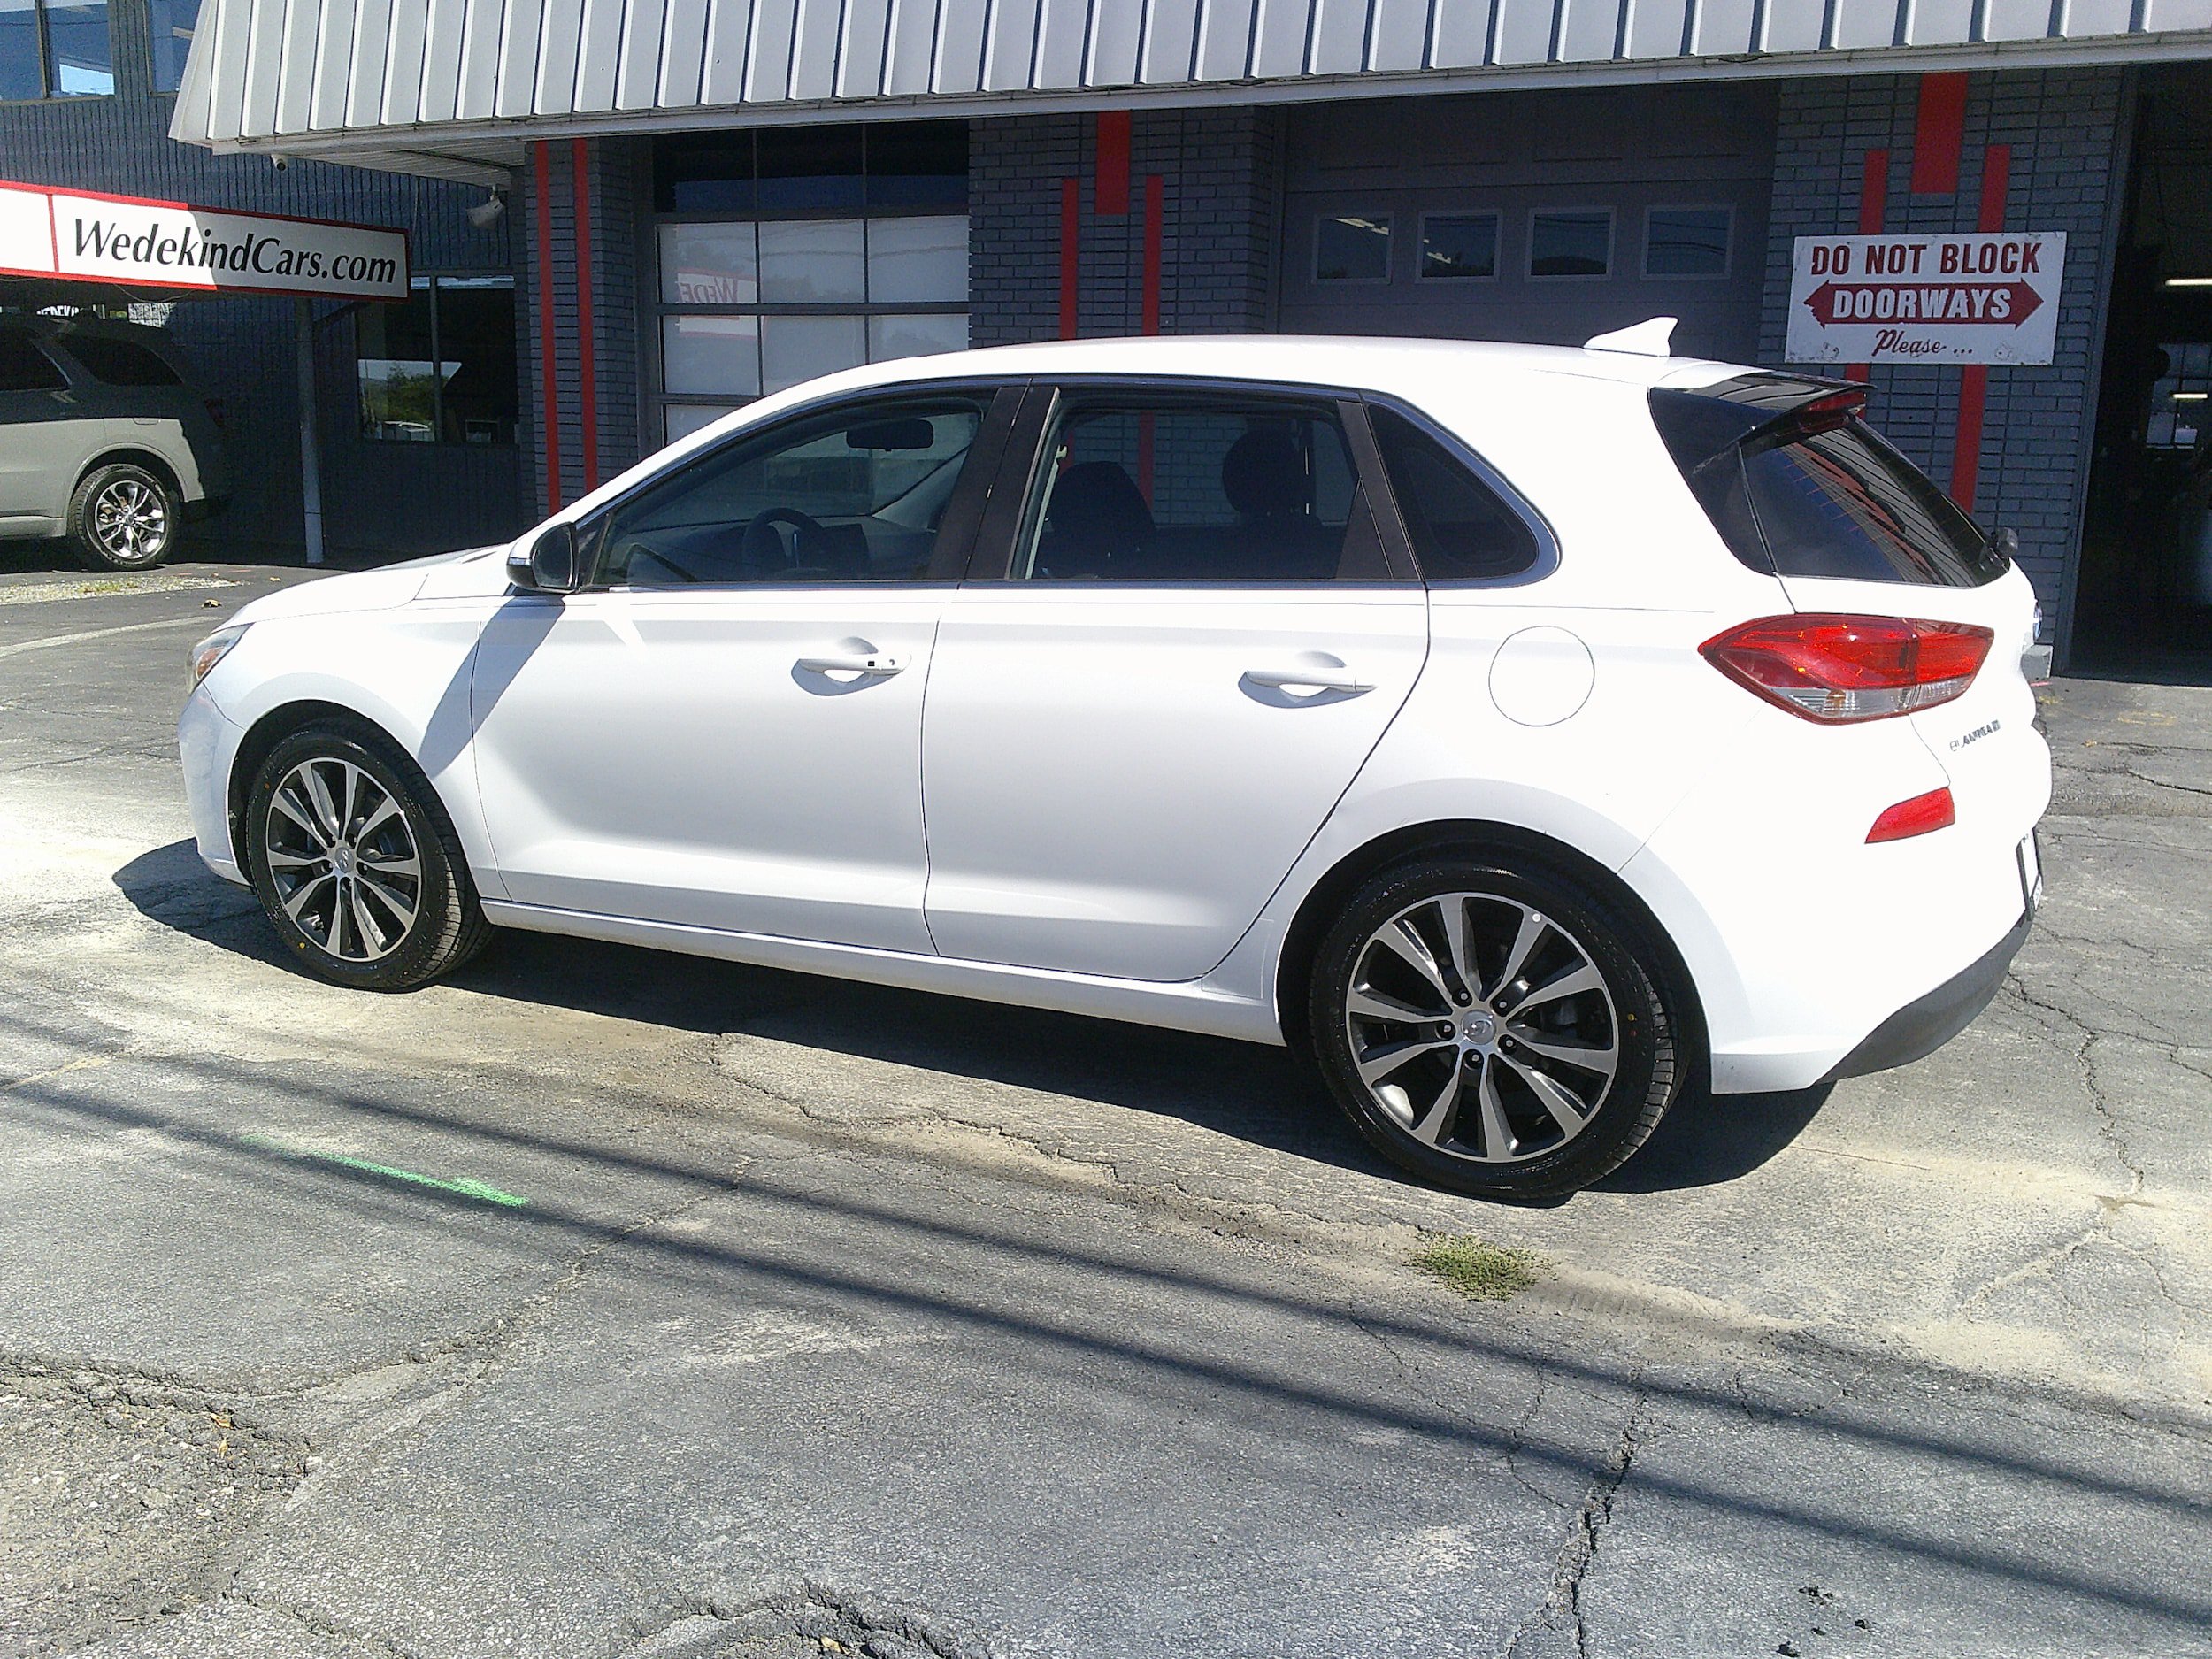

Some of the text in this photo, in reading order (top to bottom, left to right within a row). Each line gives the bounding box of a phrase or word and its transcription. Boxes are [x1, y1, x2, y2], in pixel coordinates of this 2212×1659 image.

[74, 218, 396, 284] WedekindCars.com
[1810, 242, 2042, 275] DO NOT BLOCK
[1832, 288, 2013, 319] DOORWAYS
[1870, 328, 1947, 357] Please
